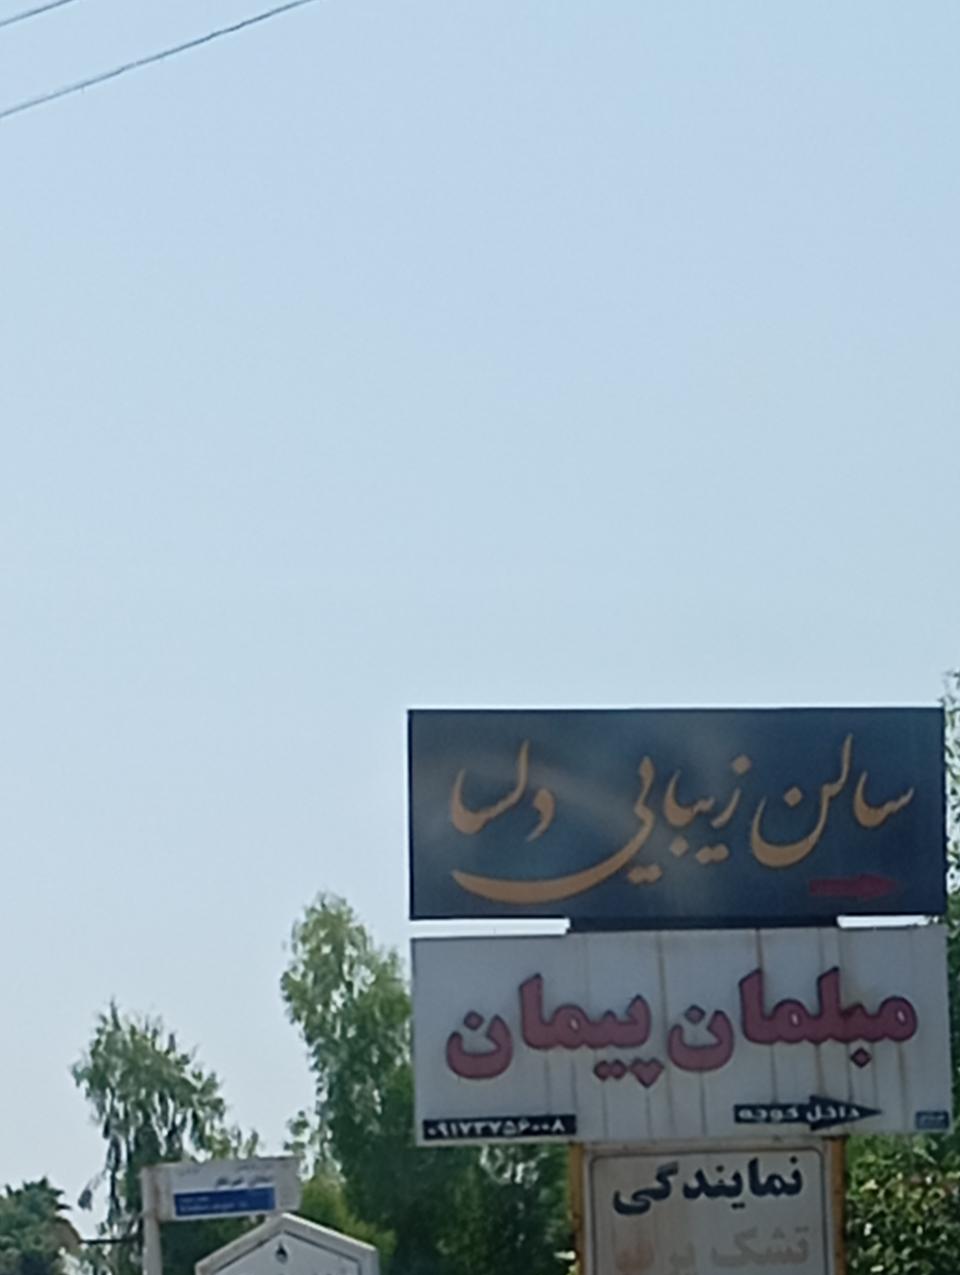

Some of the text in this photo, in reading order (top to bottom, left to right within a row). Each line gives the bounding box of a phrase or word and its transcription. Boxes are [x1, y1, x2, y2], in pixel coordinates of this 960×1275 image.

[450, 733, 915, 905] سالن زیبایی دلسا
[446, 966, 919, 1089] مبلمان پیمان
[613, 1155, 804, 1216] نمایندگی
